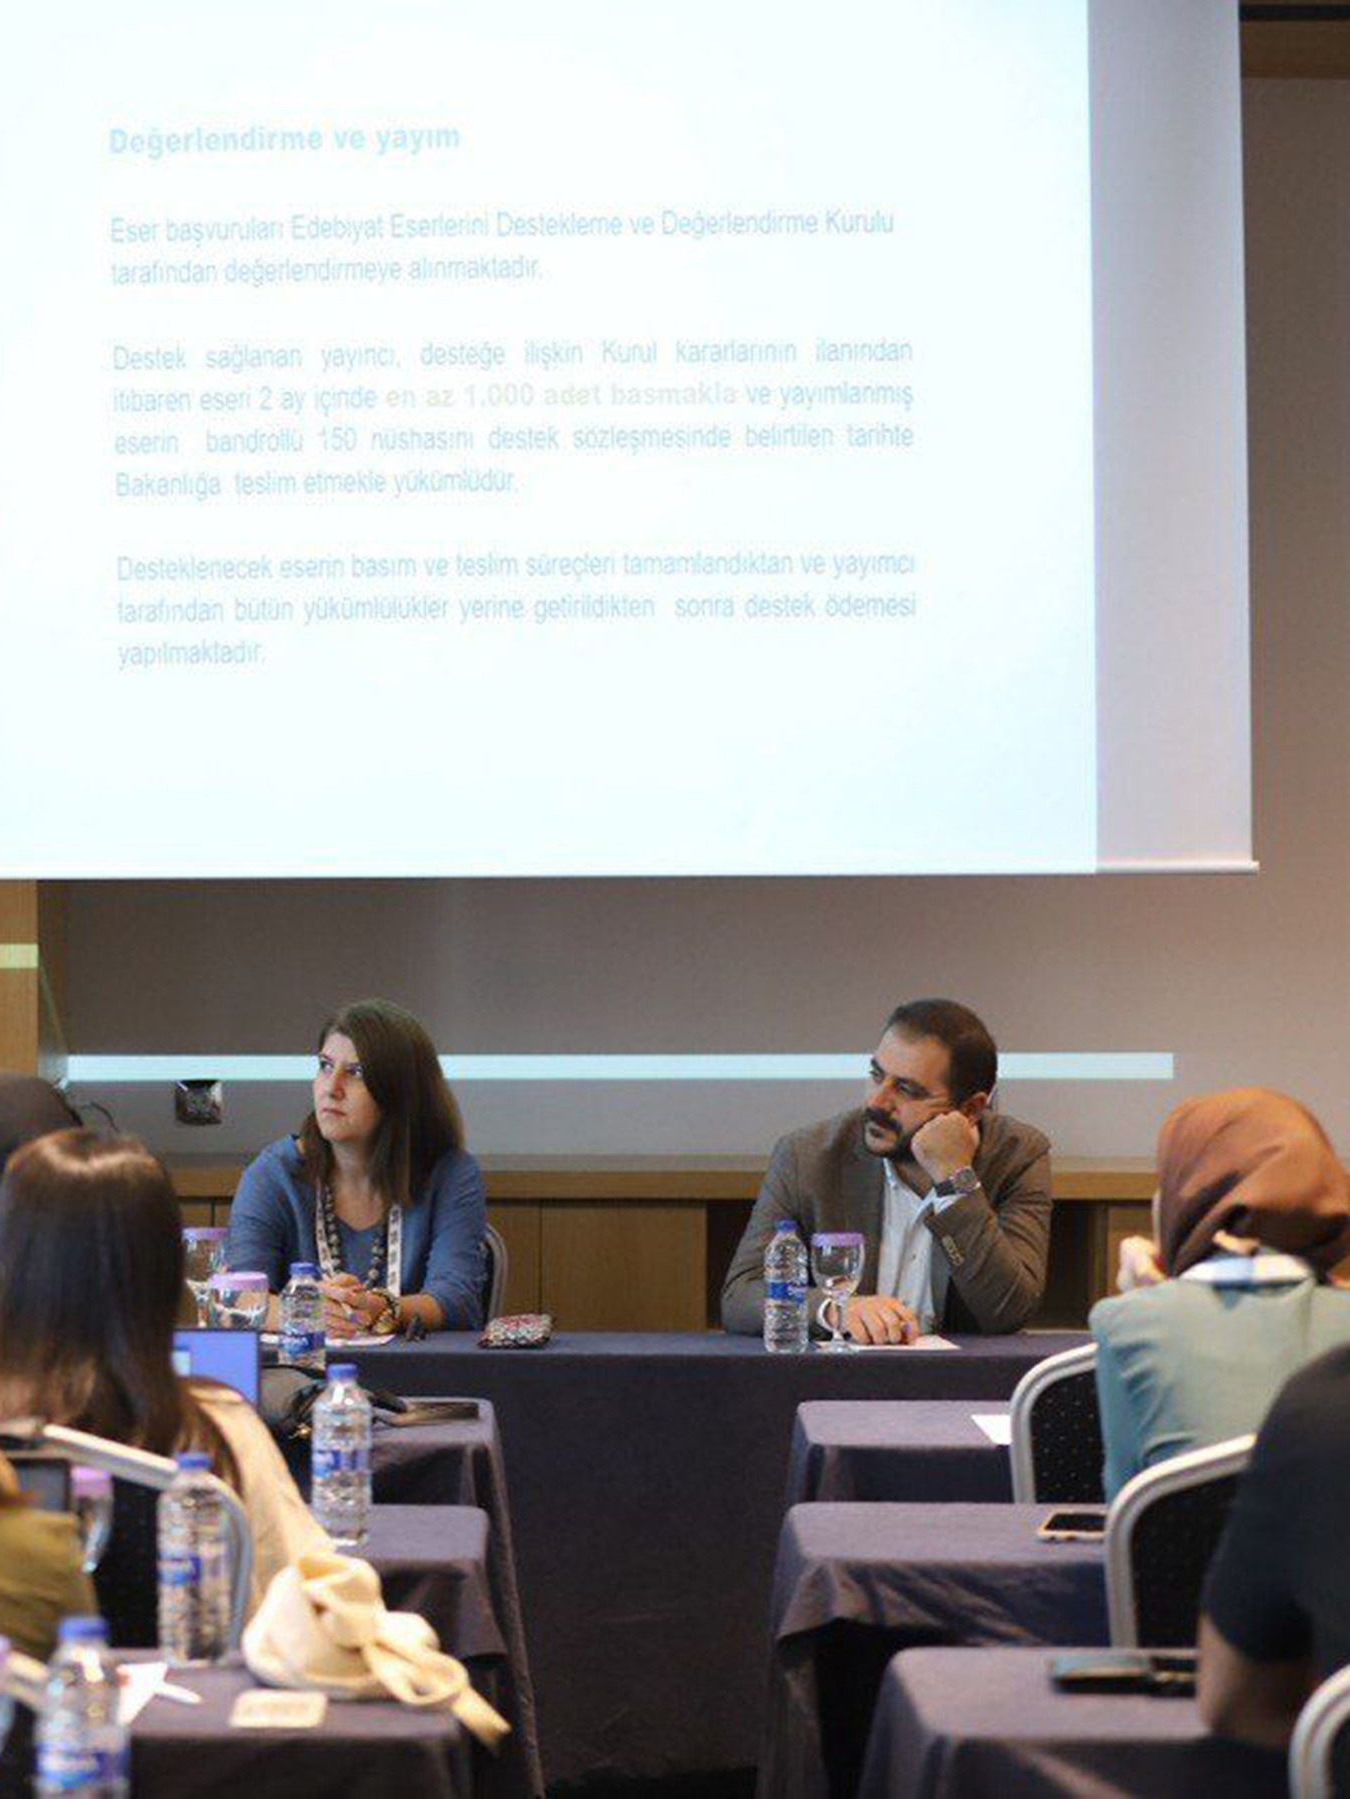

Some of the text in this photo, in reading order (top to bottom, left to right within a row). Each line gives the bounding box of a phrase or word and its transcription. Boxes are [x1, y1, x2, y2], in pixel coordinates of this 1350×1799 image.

[109, 125, 461, 159] Değerlendirme ve yayım
[110, 217, 157, 242] Eser
[496, 210, 622, 237] Destekleme
[629, 216, 655, 235] ve
[661, 207, 819, 241] Değerlendirme
[826, 206, 894, 232] Kurulu
[110, 258, 217, 284] tarafından
[224, 255, 401, 289] değerlendirmeye
[113, 344, 186, 370] Destek
[205, 342, 303, 375] sağlanan
[420, 340, 505, 372] desteğe
[601, 338, 656, 364] Kurul
[675, 337, 798, 363] kararlarının
[815, 335, 913, 361] ilanından
[257, 385, 272, 410] 2
[278, 391, 304, 416] ay
[312, 384, 378, 416] içinde
[386, 389, 416, 409] en
[427, 389, 454, 408] az
[544, 381, 601, 407] adet
[610, 379, 738, 406] basmakla
[745, 385, 772, 404] ve
[779, 377, 913, 410] yayımlanmış
[114, 430, 179, 453] eserin
[321, 426, 356, 451] 150
[488, 424, 558, 450] destek
[572, 423, 731, 455] sözleşmesinde
[745, 422, 834, 447] belirtilen
[847, 421, 913, 446] tarihte
[114, 470, 221, 503] Bakanlığa
[235, 469, 297, 495] teslim
[303, 467, 389, 494] etmekle
[117, 554, 273, 580] Desteklenecek
[280, 556, 344, 579] eserin
[351, 552, 418, 578] basım
[424, 558, 450, 577] ve
[455, 551, 519, 577] teslim
[526, 550, 617, 582] süreçleri
[622, 548, 795, 575] tamamlandıktan
[800, 554, 826, 573] ve
[117, 596, 224, 622] tarafından
[235, 595, 295, 621] bütün
[458, 597, 525, 625] yerine
[534, 593, 655, 625] getirildikten
[675, 598, 735, 618] sonra
[743, 592, 817, 617] destek
[825, 591, 916, 617] ödemesi
